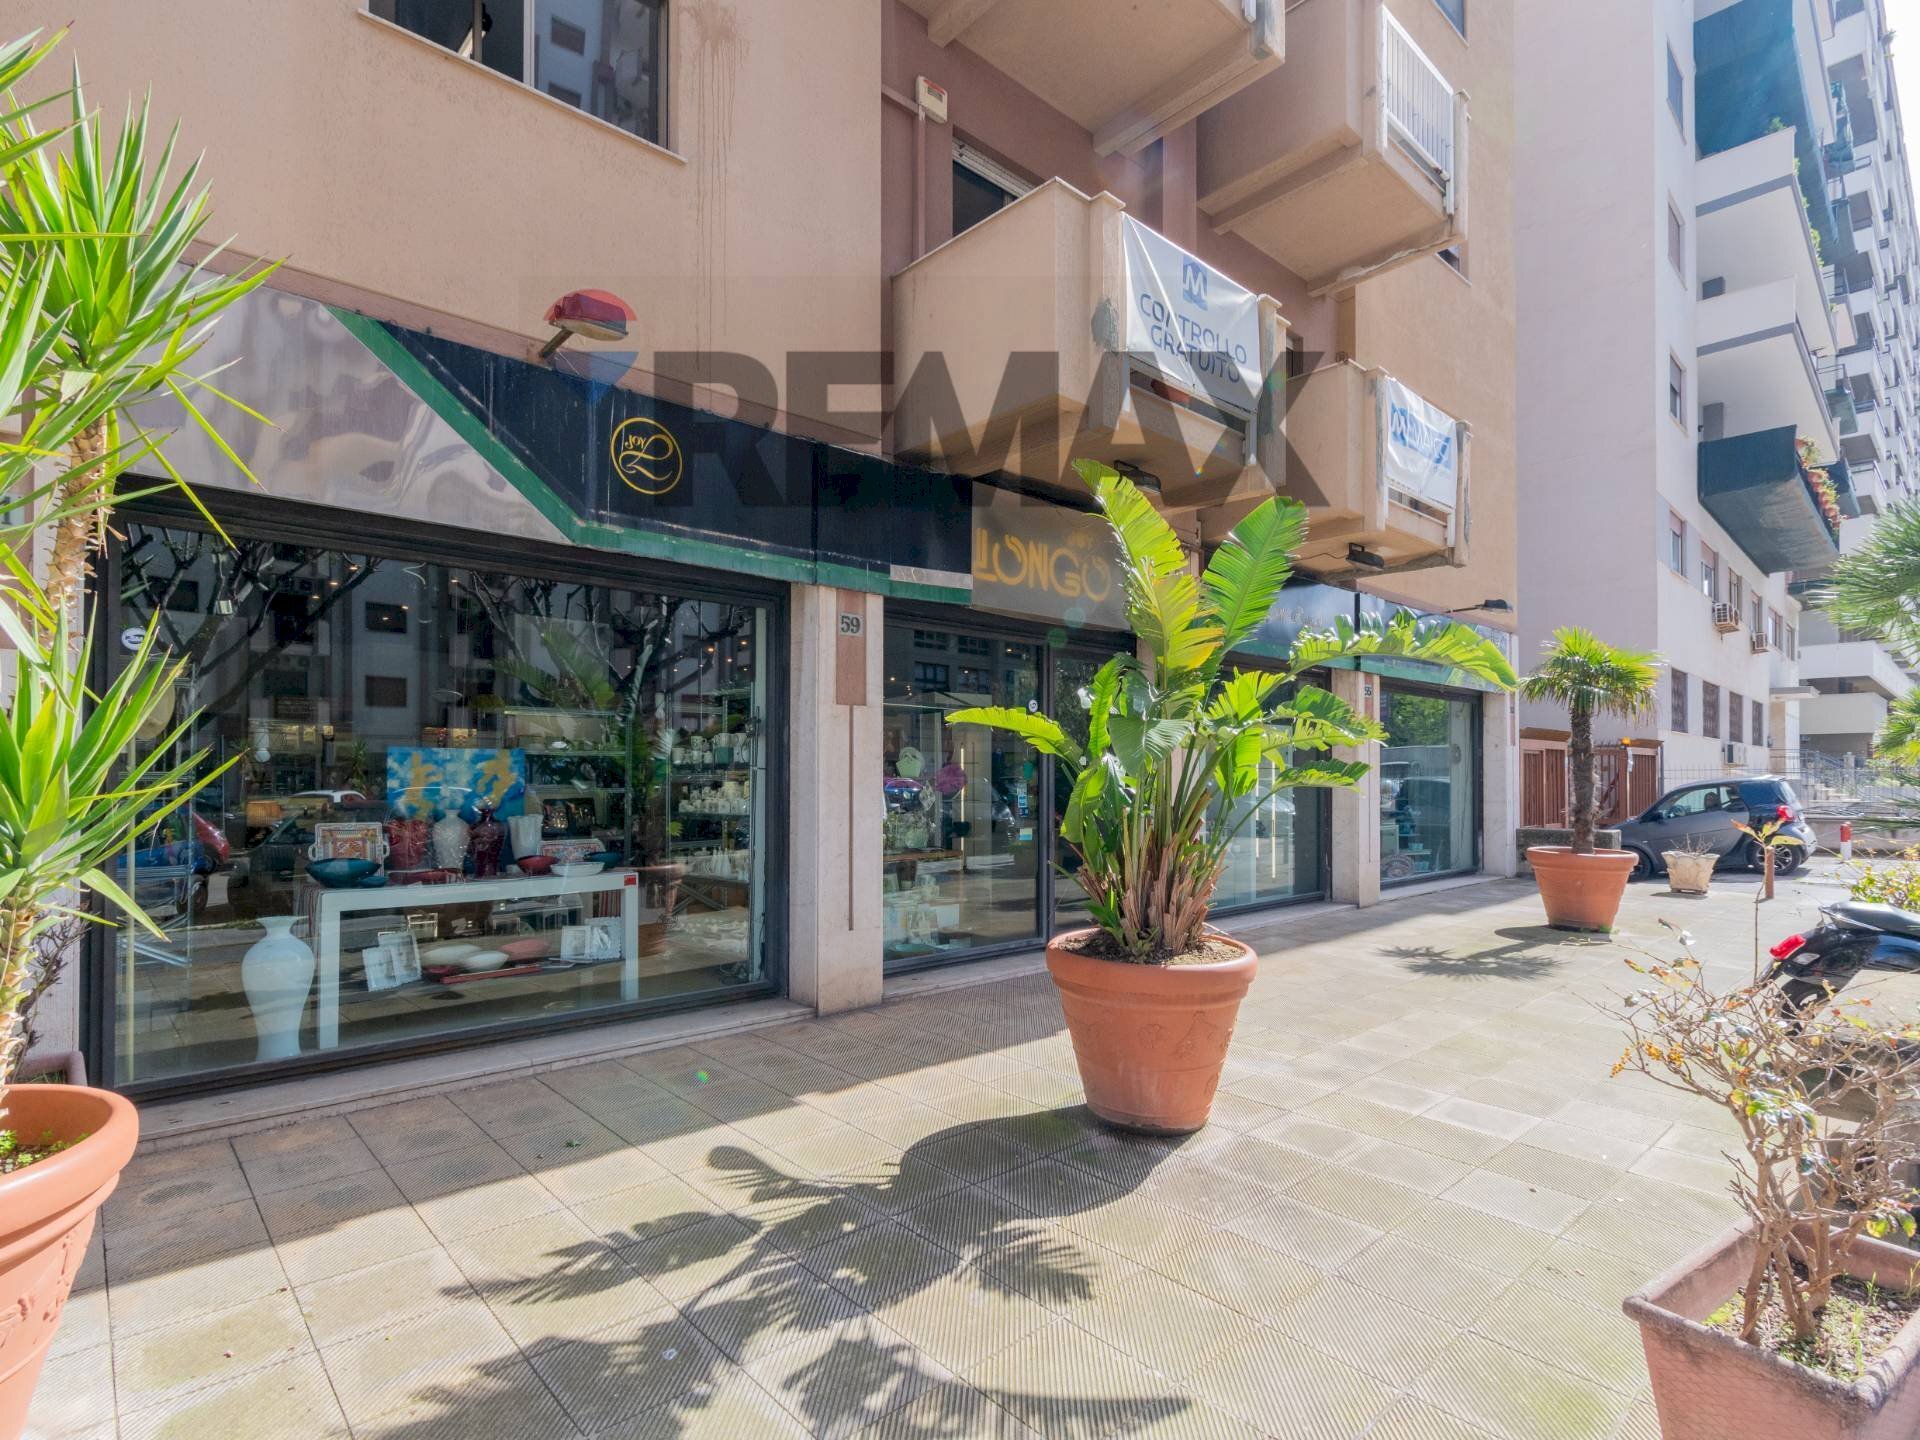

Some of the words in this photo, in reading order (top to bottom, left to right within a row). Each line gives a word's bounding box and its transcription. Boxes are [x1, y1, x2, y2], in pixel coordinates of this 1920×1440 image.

[1151, 324, 1240, 384] GRATUITO
[625, 434, 647, 450] JOY
[971, 527, 1112, 602] LONGO
[841, 615, 861, 634] 59
